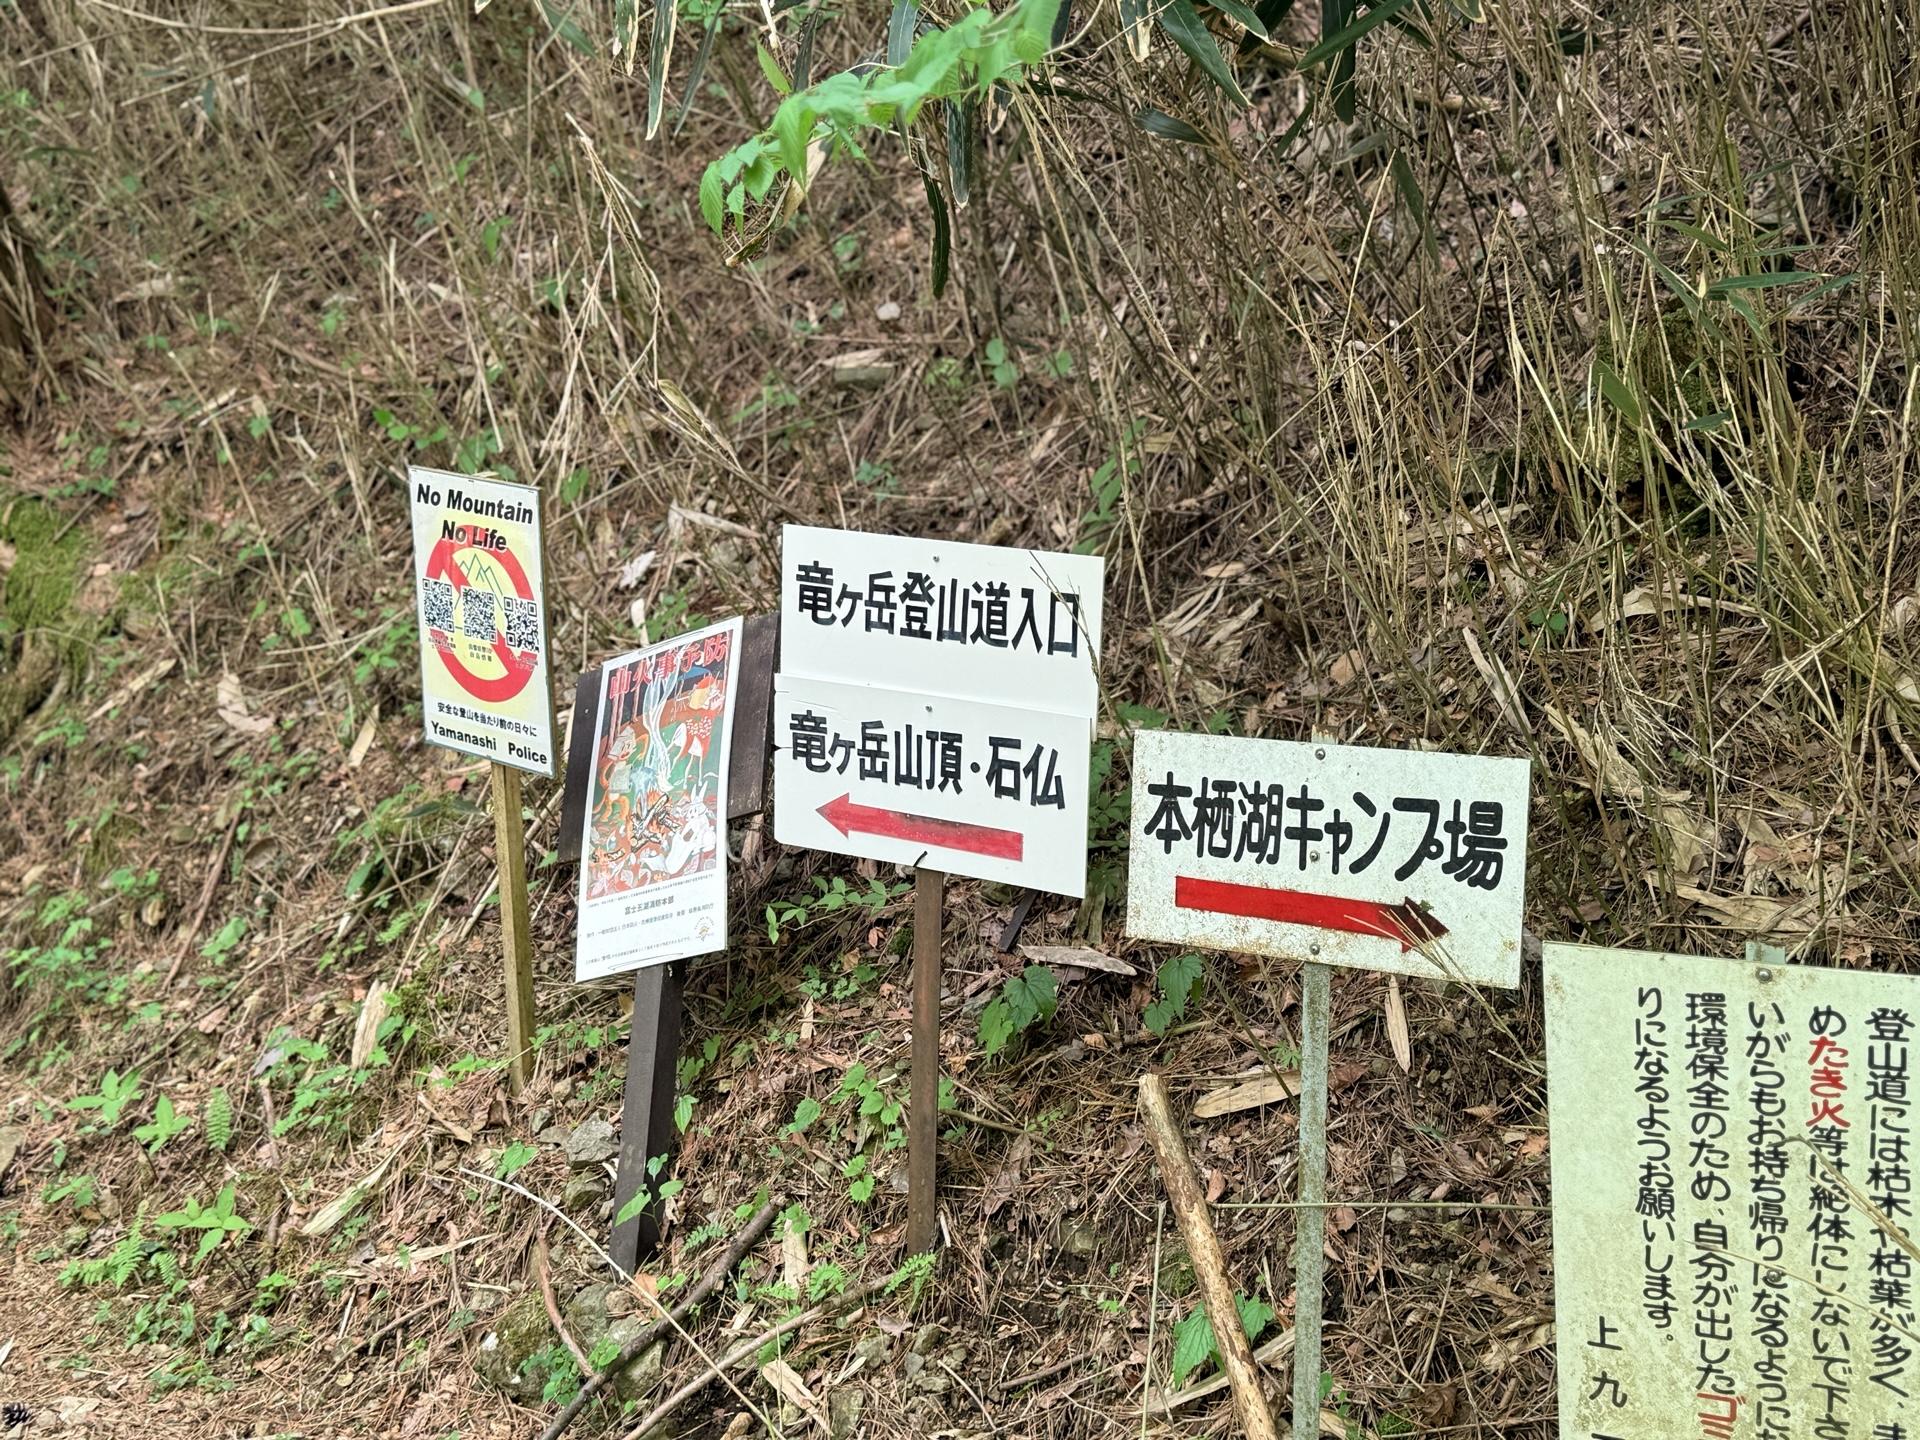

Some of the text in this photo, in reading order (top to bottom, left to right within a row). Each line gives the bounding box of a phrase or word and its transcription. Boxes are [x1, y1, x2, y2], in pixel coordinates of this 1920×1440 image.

[417, 483, 533, 524] No Mountain
[441, 520, 507, 550] No Life
[609, 632, 730, 700] 山火事予防
[437, 702, 537, 737] 安全な登山を当たり前の日々に
[431, 720, 547, 764] Yamanashi Police
[1143, 771, 1508, 890] 本栖湖キャンプ場
[1633, 987, 1679, 1341] りになるようお願いします。
